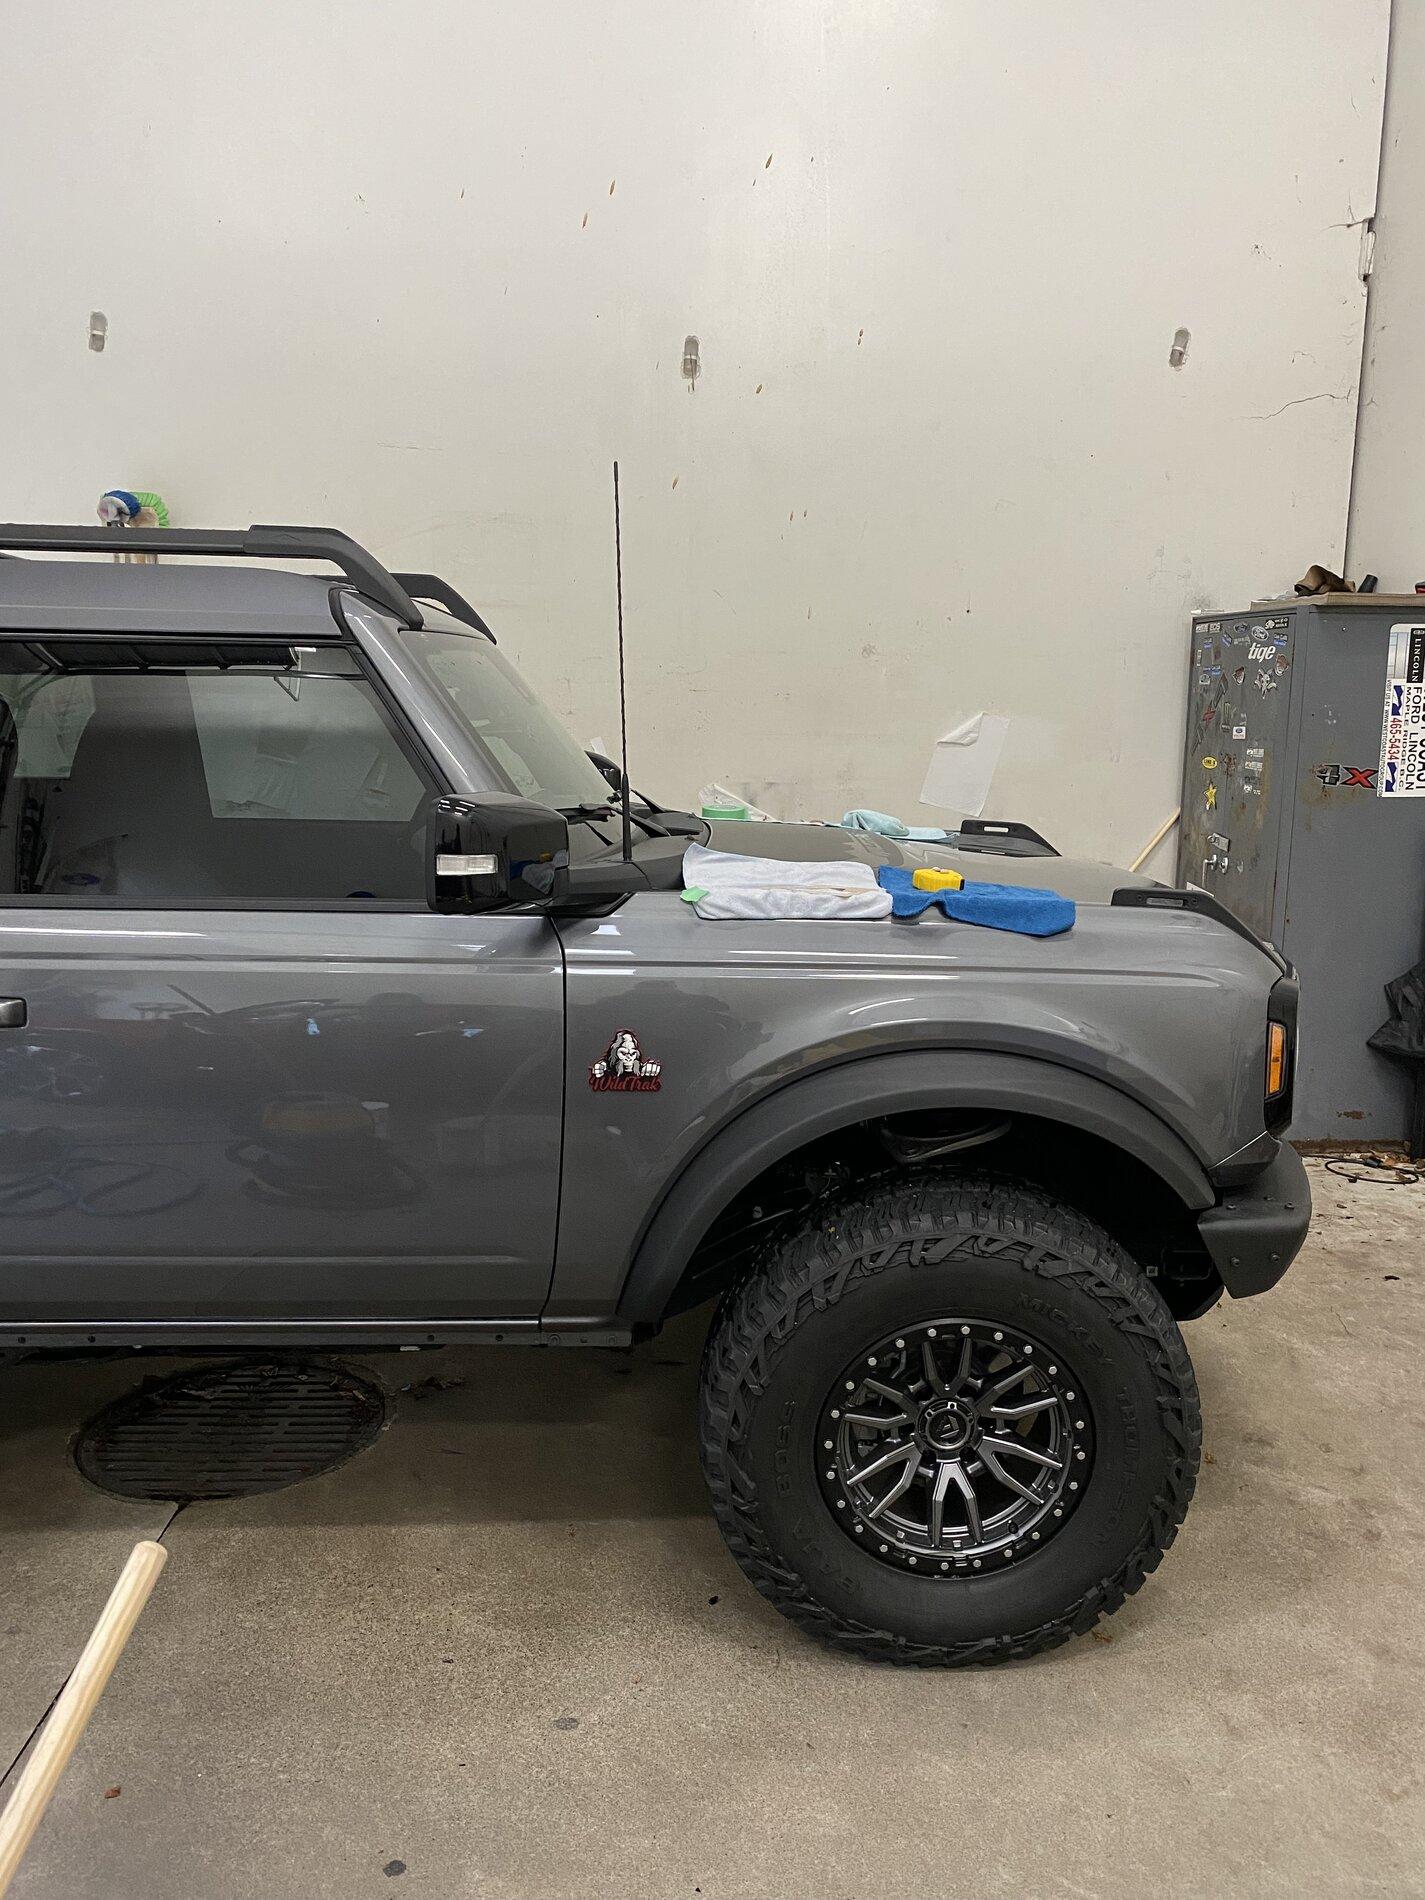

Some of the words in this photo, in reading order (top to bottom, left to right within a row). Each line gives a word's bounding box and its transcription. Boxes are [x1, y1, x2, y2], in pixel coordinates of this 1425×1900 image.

[1412, 638, 1422, 682] LINCOLN
[1404, 687, 1412, 726] MAPLE
[1410, 687, 1423, 724] FORD
[1387, 717, 1402, 761] 465-5434
[1400, 730, 1409, 765] RIDGE
[1405, 732, 1419, 790] LINCOLN
